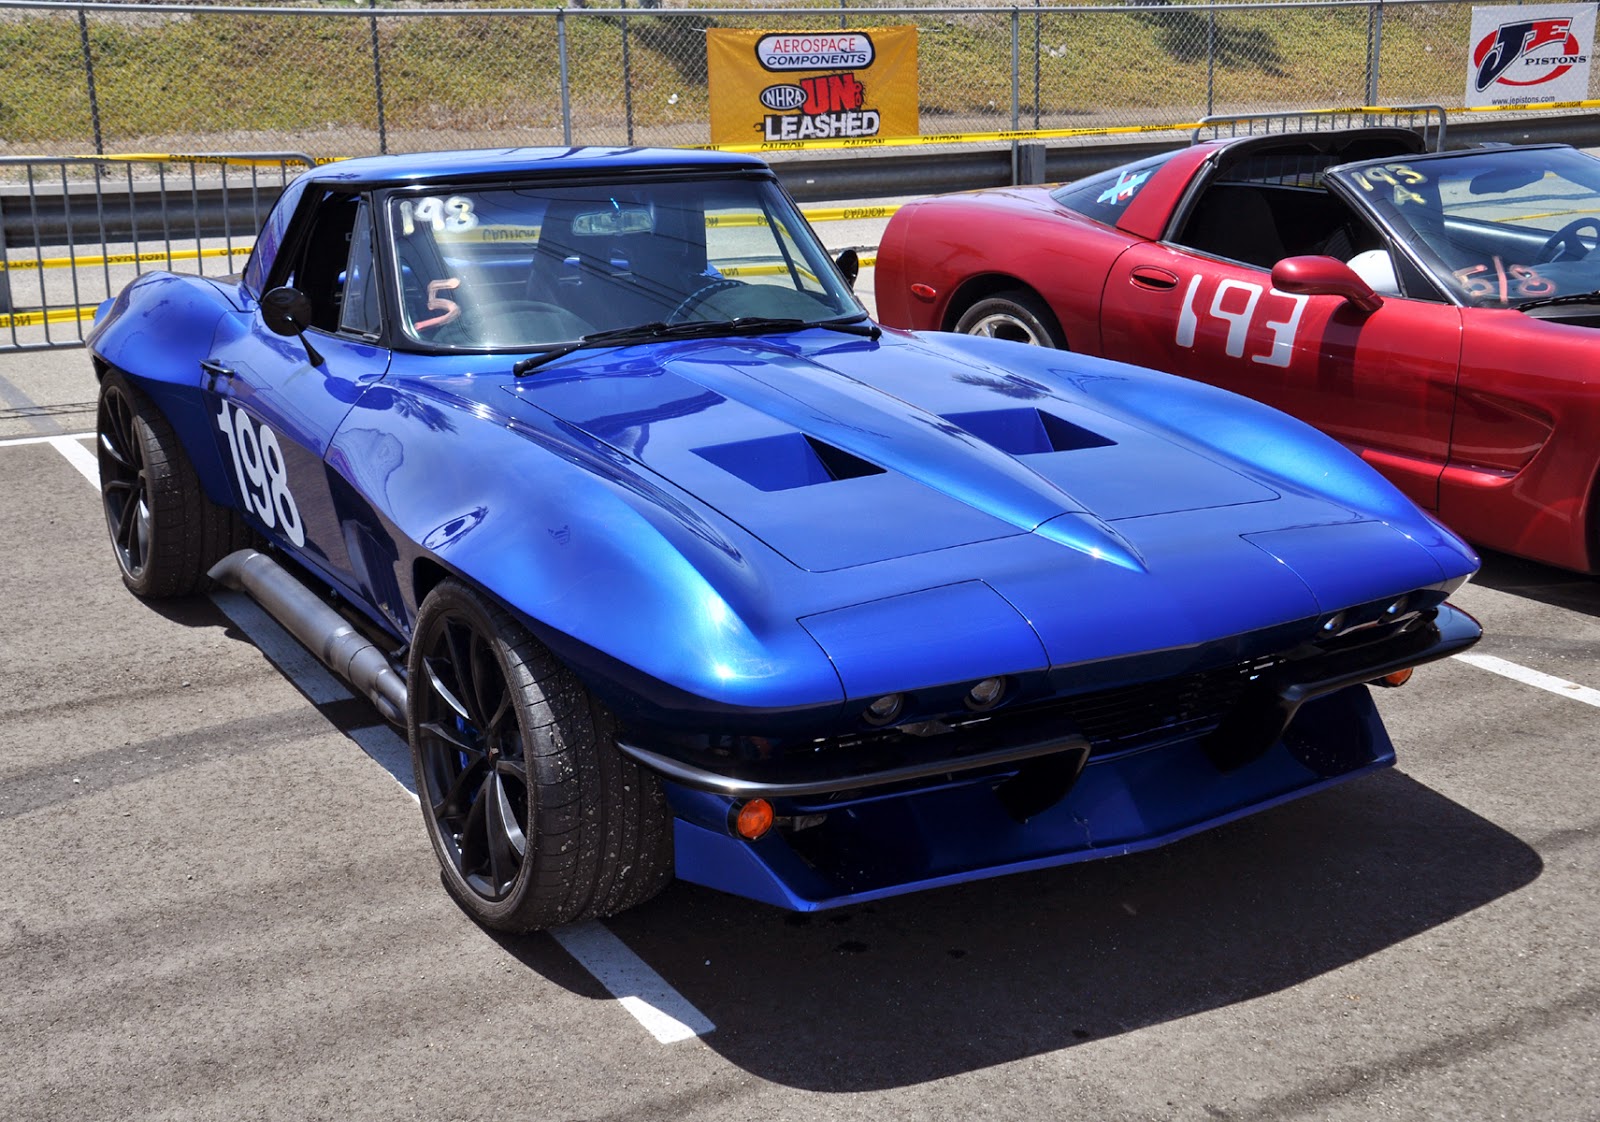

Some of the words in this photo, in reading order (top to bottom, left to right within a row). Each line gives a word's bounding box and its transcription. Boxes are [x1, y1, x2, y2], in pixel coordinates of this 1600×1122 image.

[766, 53, 866, 66] COMPONENTS
[773, 37, 856, 53] AEROSPACE
[1475, 17, 1573, 93] JE
[1524, 55, 1587, 66] PISTONS
[766, 88, 802, 107] NHRA
[1491, 95, 1556, 105] www.jepistons.com
[765, 111, 880, 141] LEASHED
[1350, 164, 1428, 192] 193
[400, 196, 479, 236] 198
[413, 278, 461, 331] 5
[1175, 274, 1310, 368] 193
[217, 398, 305, 548] 198
